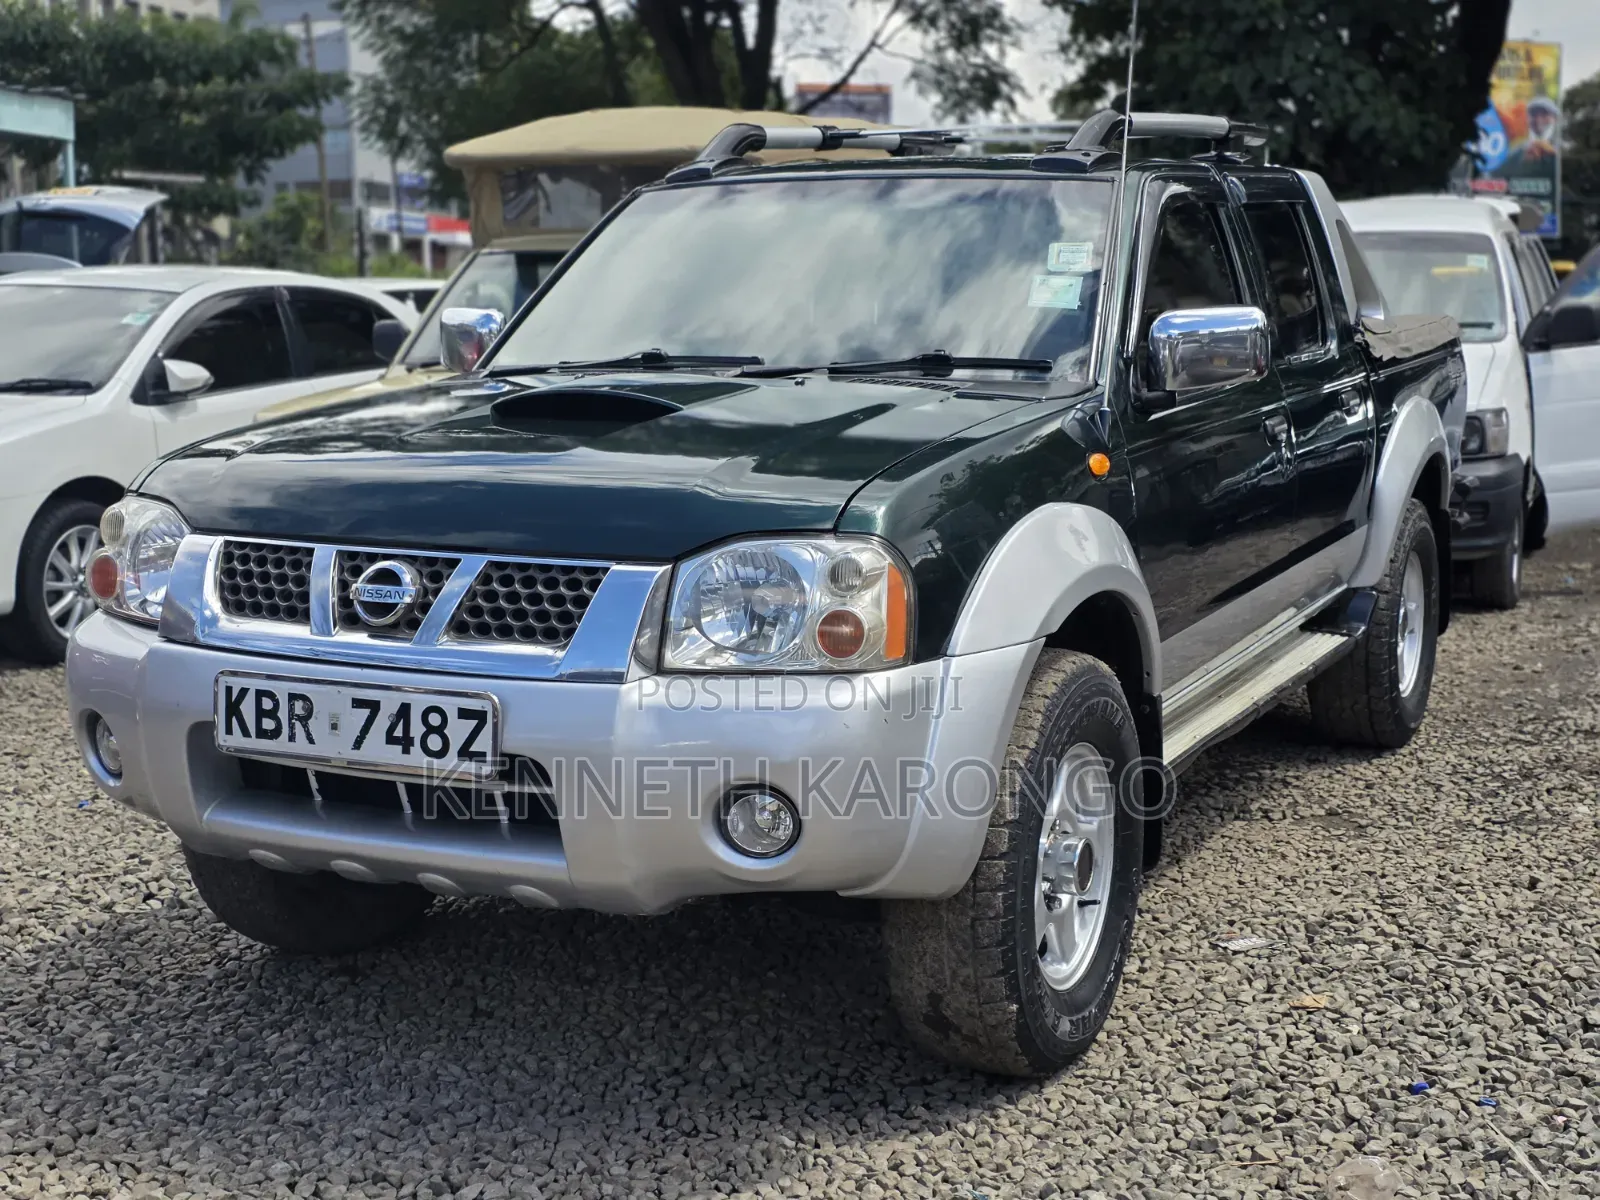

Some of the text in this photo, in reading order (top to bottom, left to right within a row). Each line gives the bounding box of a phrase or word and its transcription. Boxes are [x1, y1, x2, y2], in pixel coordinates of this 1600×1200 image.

[354, 587, 406, 600] NISSAN
[224, 685, 488, 763] KBR 748Z
